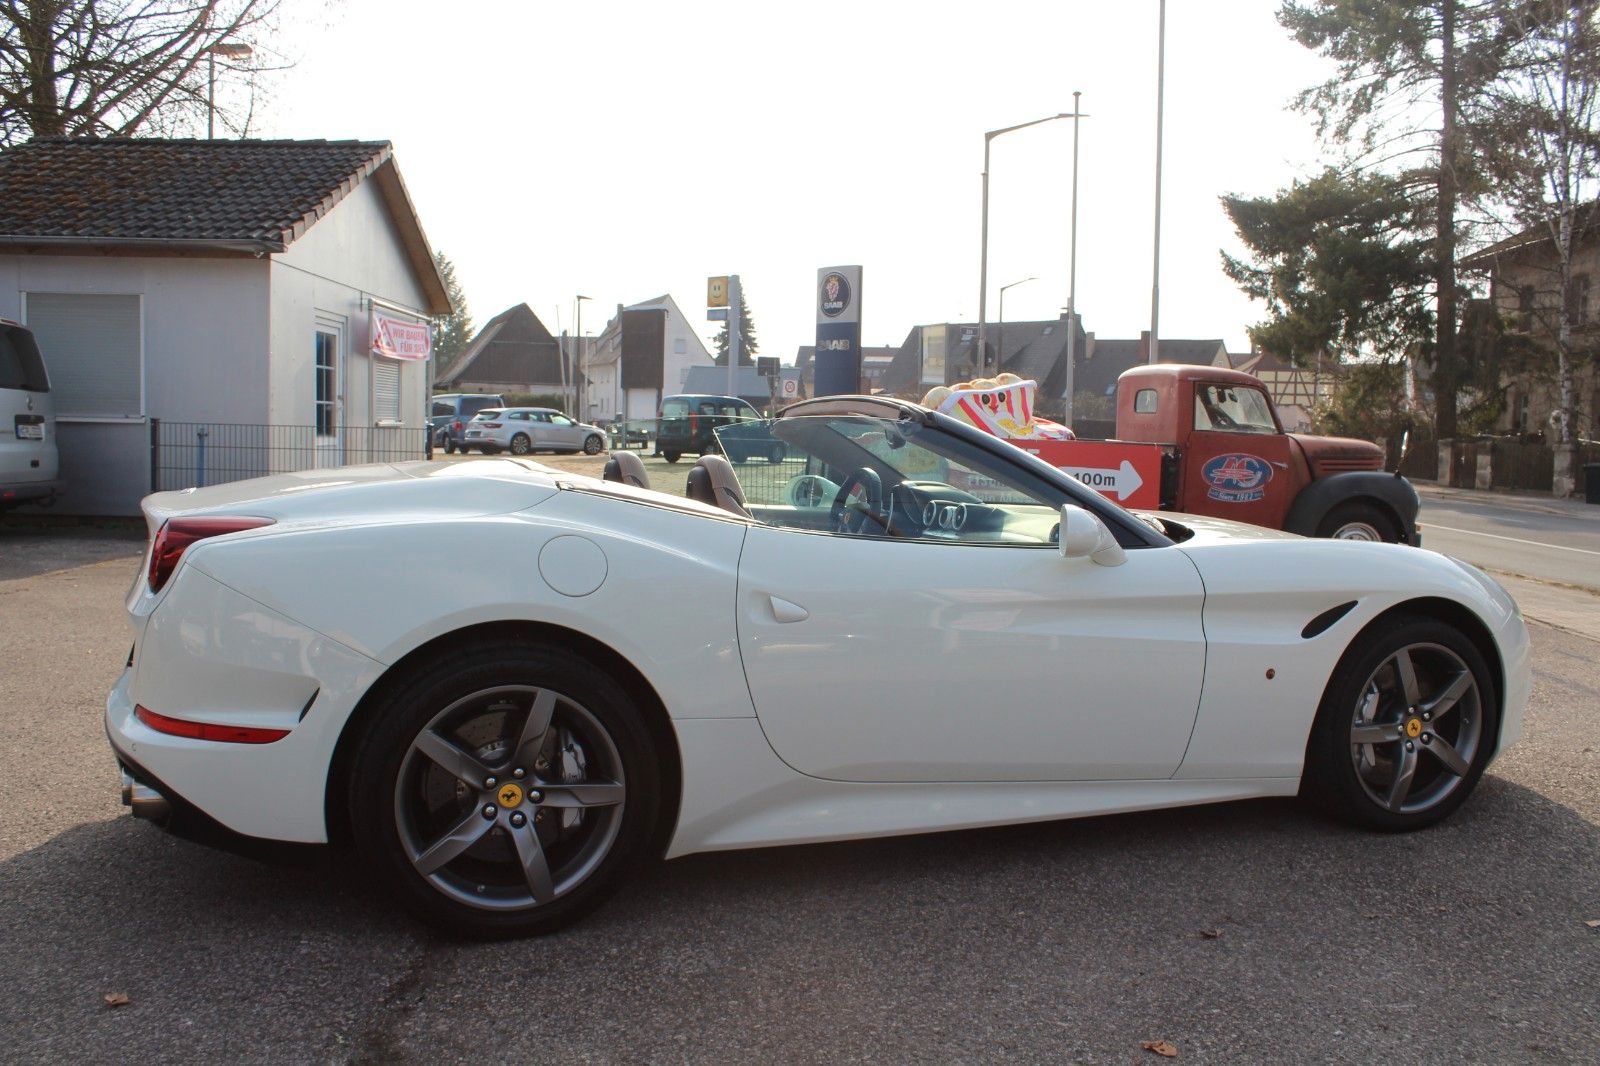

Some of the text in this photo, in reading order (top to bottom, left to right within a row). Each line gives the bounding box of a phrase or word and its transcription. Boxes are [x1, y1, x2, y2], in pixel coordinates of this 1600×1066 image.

[393, 329, 404, 339] WIR
[817, 339, 849, 351] SAAB
[1074, 472, 1116, 486] 100m
